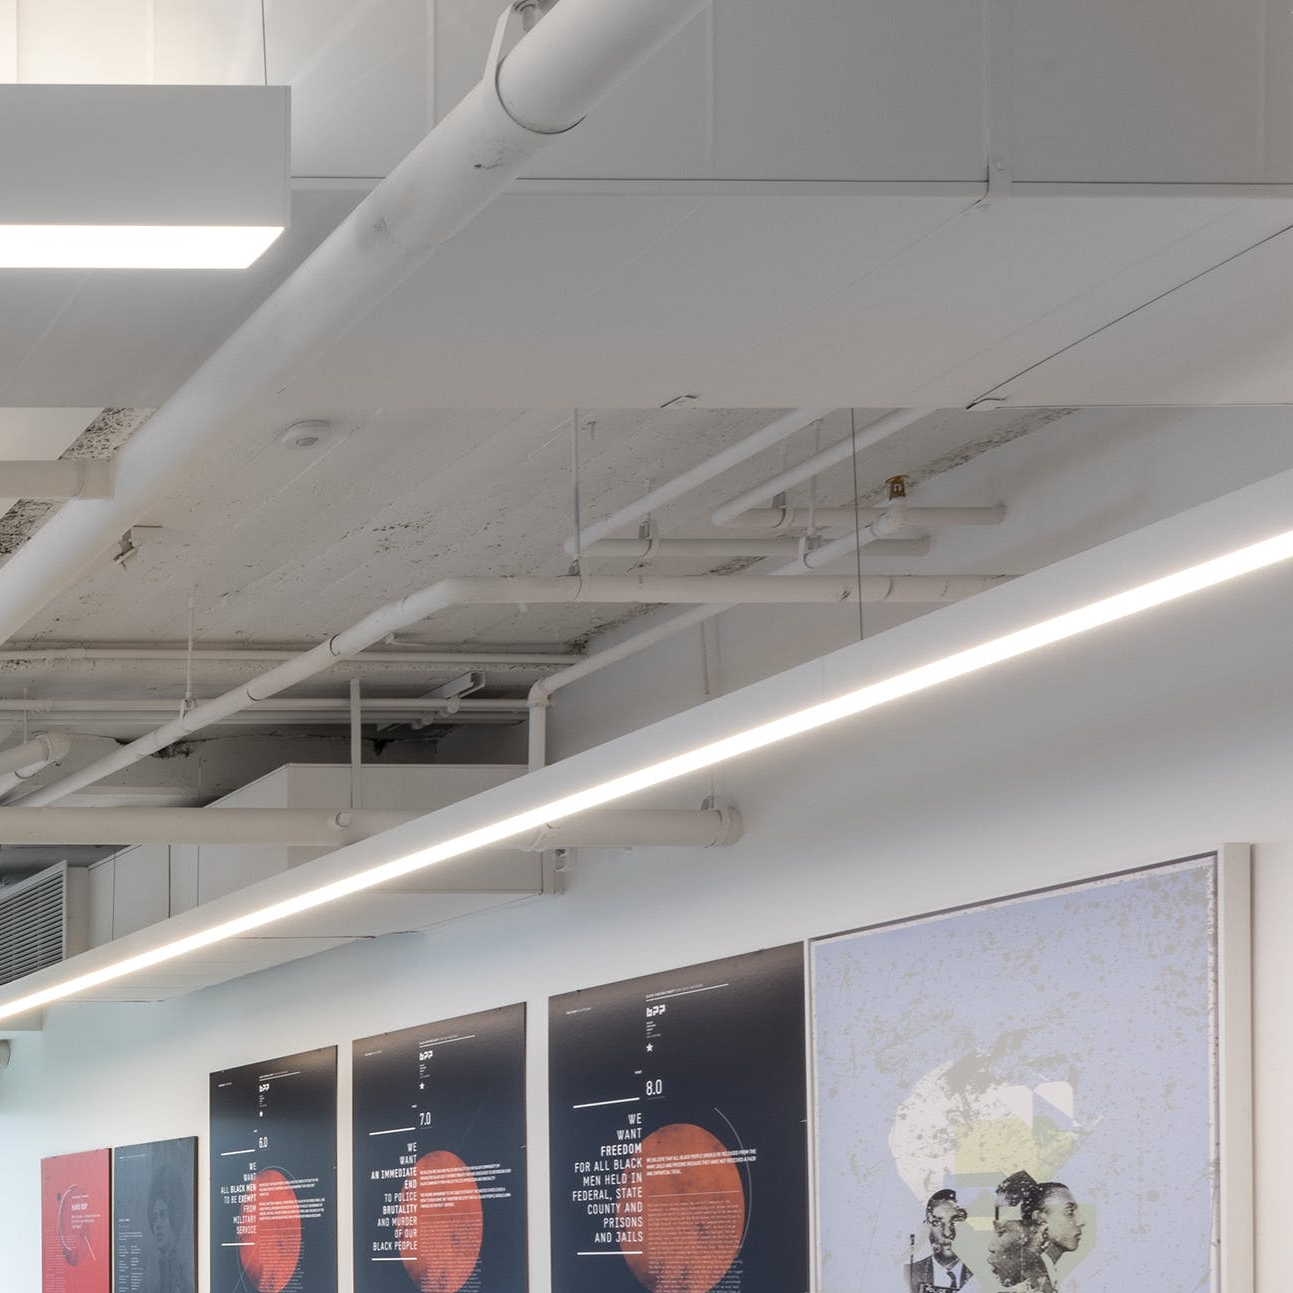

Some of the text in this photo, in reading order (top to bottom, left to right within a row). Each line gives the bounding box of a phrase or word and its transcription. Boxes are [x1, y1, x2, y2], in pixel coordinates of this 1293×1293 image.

[646, 1079, 662, 1095] 8.0
[420, 1112, 431, 1125] 7.0
[628, 1113, 642, 1124] WE
[616, 1128, 642, 1140] WANT
[407, 1143, 417, 1152] WE
[601, 1143, 642, 1156] FREEDOM
[400, 1155, 417, 1165] WANT
[574, 1162, 590, 1173] FOR
[594, 1160, 609, 1171] ALL
[614, 1158, 642, 1170] BLACK
[244, 1173, 256, 1181] WANT
[371, 1167, 417, 1180] AN IMMEDIATE
[583, 1172, 642, 1186] MEN HELD IN
[230, 1184, 245, 1193] BLACK
[405, 1179, 417, 1189] END
[231, 1195, 237, 1203] BE
[239, 1194, 256, 1203] EXEMPT
[384, 1192, 417, 1203] TO POLICE
[573, 1187, 643, 1202] FEDERAL, STATE
[383, 1204, 417, 1215] BRUTALITY
[587, 1202, 643, 1215] COUNTY AND
[233, 1215, 256, 1224] MILITARY
[377, 1216, 417, 1227] AND MURDER
[603, 1217, 643, 1228] PRISONS
[394, 1229, 417, 1238] OF OUR
[594, 1231, 643, 1243] AND JAILS
[373, 1240, 417, 1251] BLACK PEOPLE
